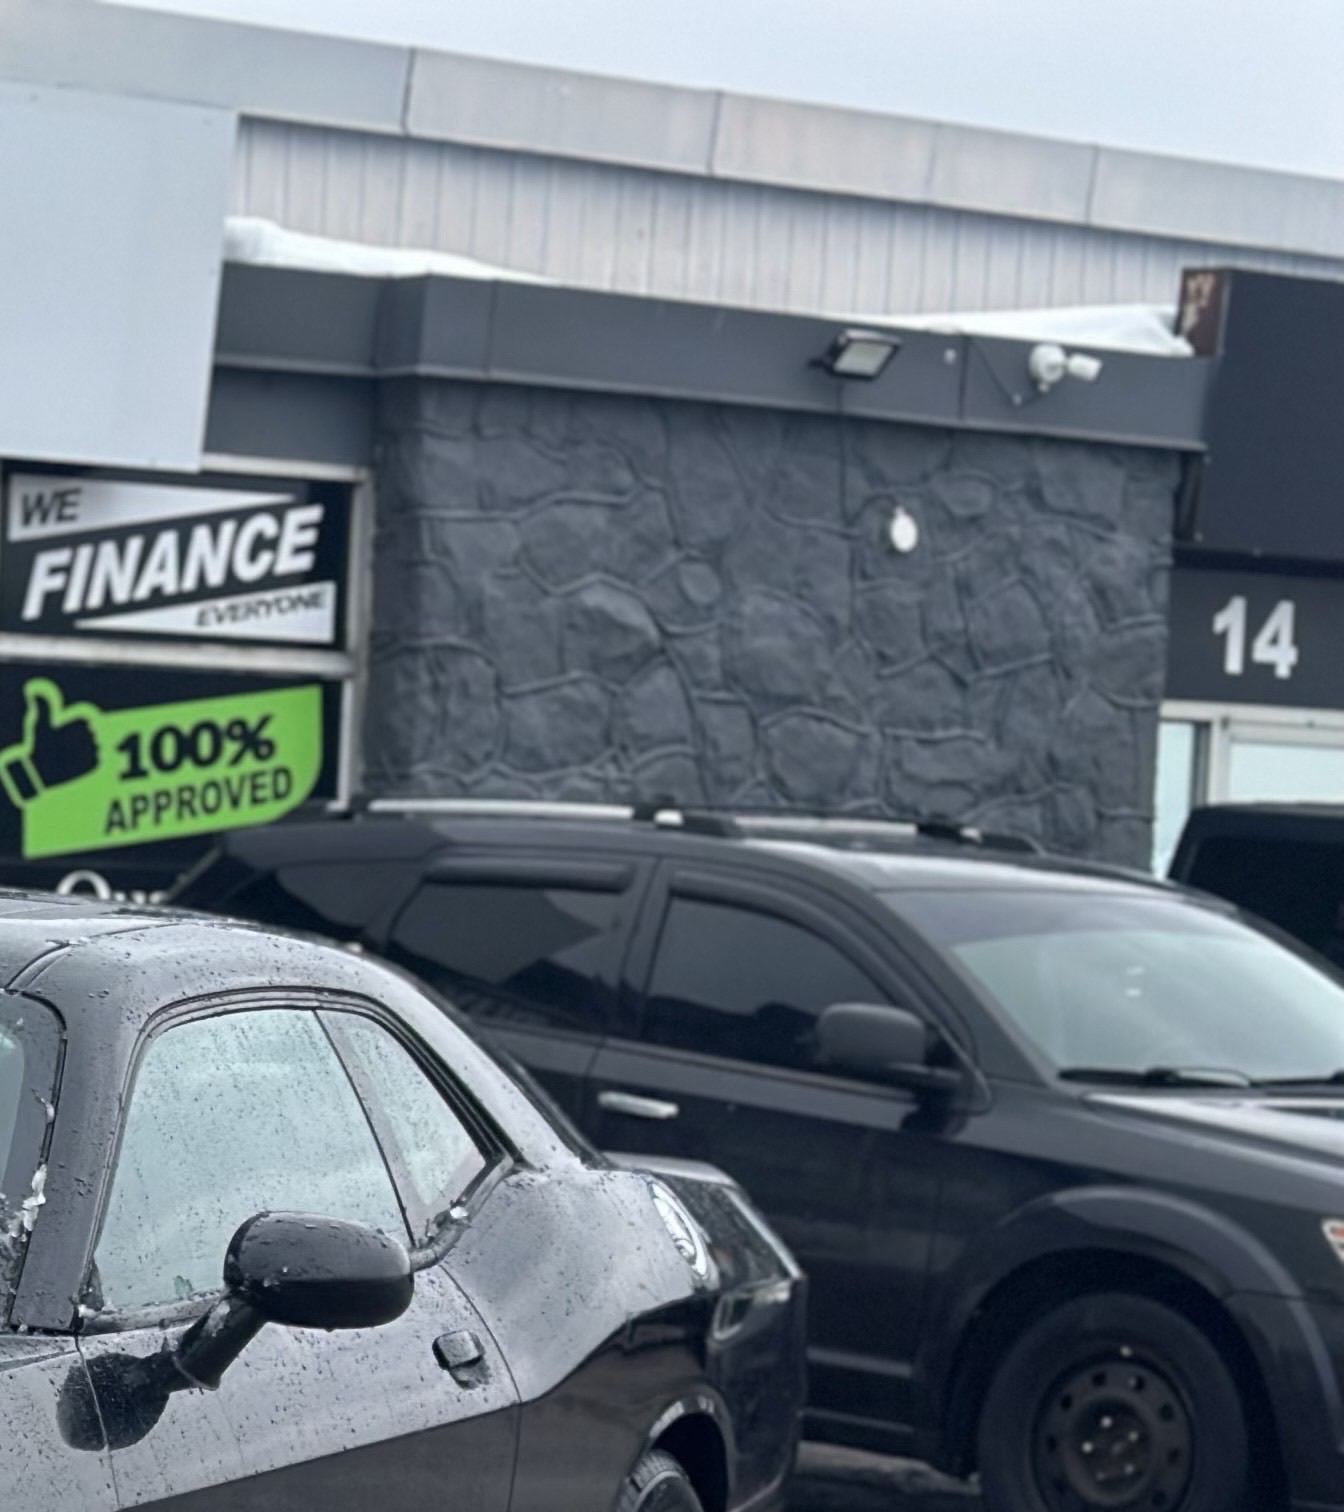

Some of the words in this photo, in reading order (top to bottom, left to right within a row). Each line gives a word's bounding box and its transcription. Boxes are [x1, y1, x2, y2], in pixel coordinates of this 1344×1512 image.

[20, 487, 82, 527] WE
[21, 504, 324, 621] FINANCE
[195, 589, 326, 628] EVERYONE
[1212, 595, 1299, 679] 14
[116, 714, 277, 781] 100%
[103, 766, 293, 836] APPROVED
